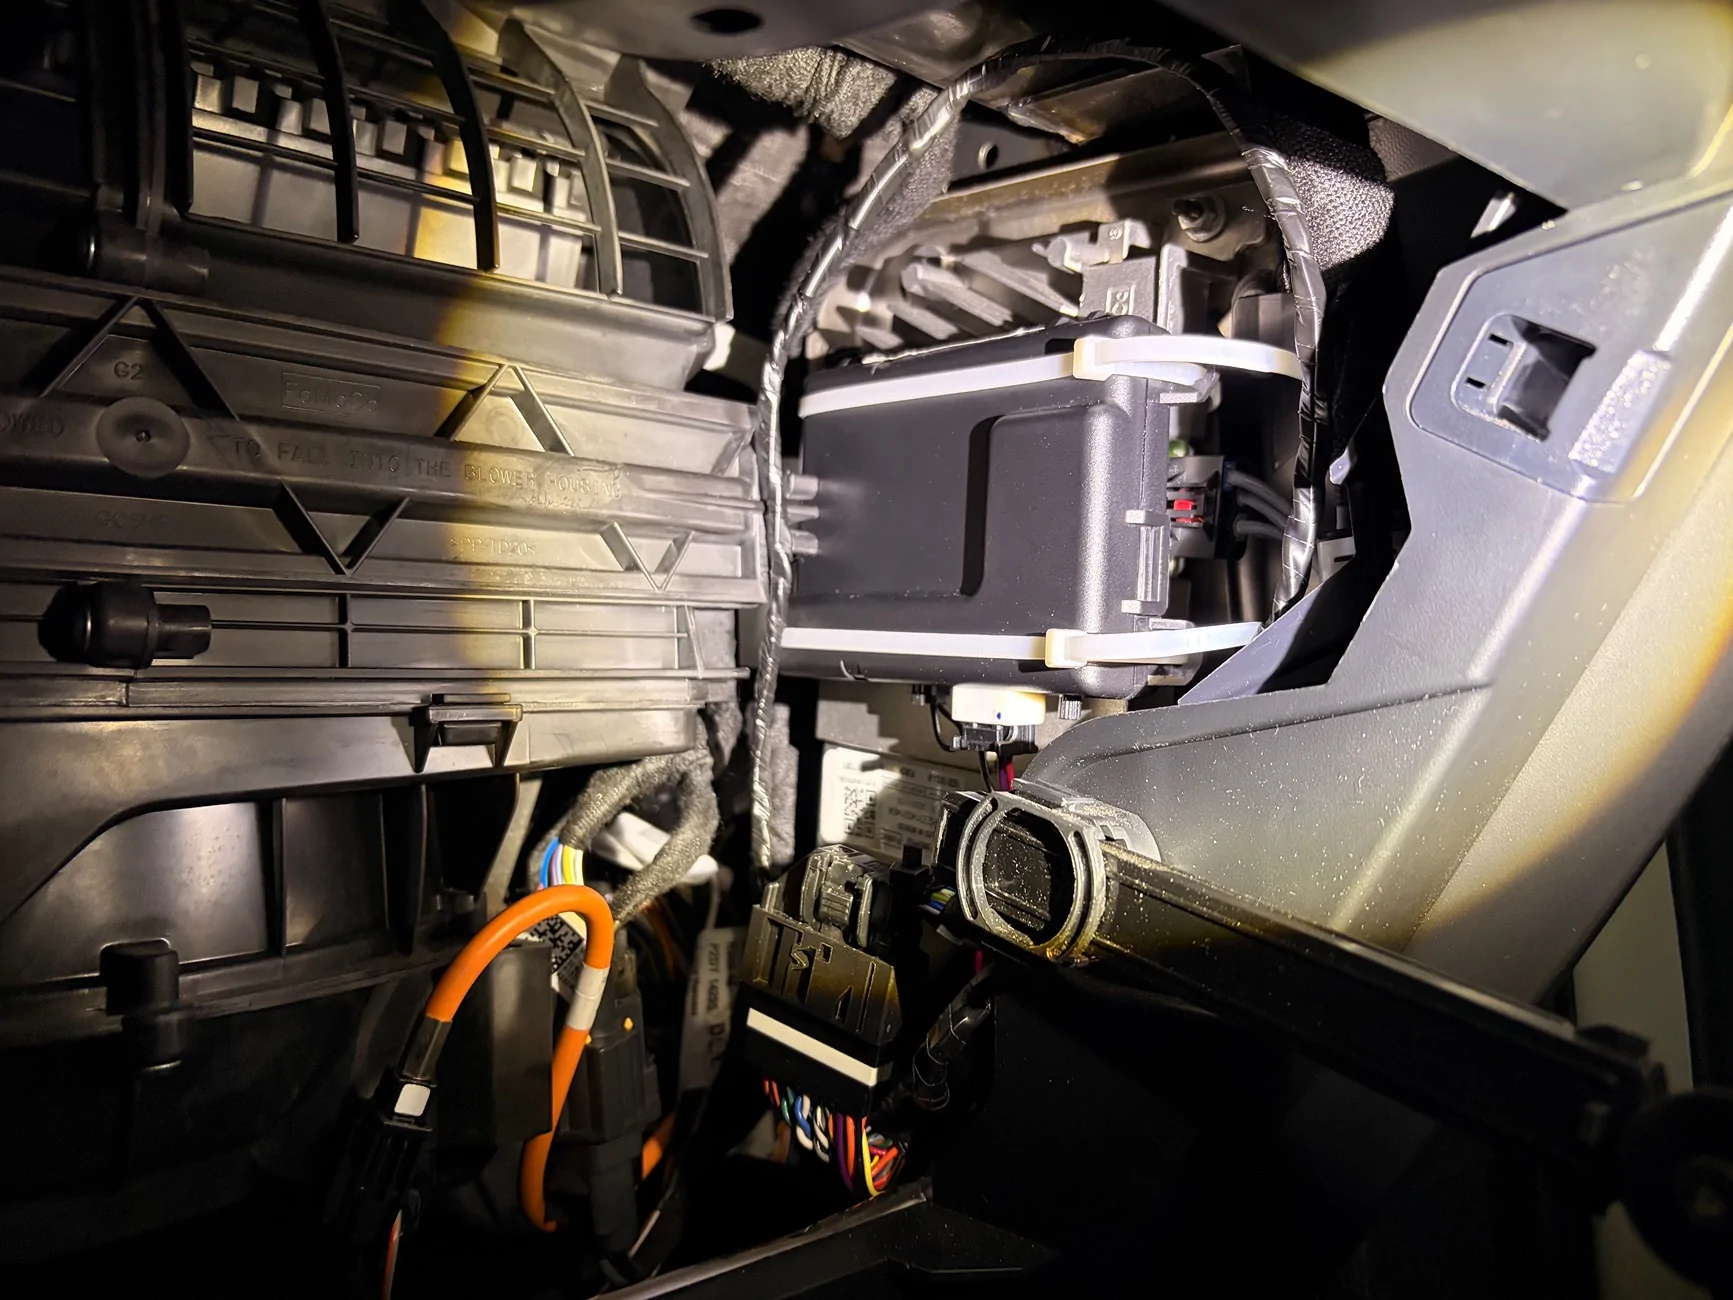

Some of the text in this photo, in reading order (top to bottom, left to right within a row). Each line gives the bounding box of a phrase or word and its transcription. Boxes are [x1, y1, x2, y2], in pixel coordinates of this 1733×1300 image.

[113, 360, 146, 381] G2
[284, 380, 378, 413] FoMoCo
[232, 437, 261, 461] TO
[277, 441, 331, 468] FALL
[349, 449, 401, 474] INTO
[414, 458, 453, 479] THE
[464, 463, 537, 489] BLOWER
[546, 476, 622, 500] HOUSING
